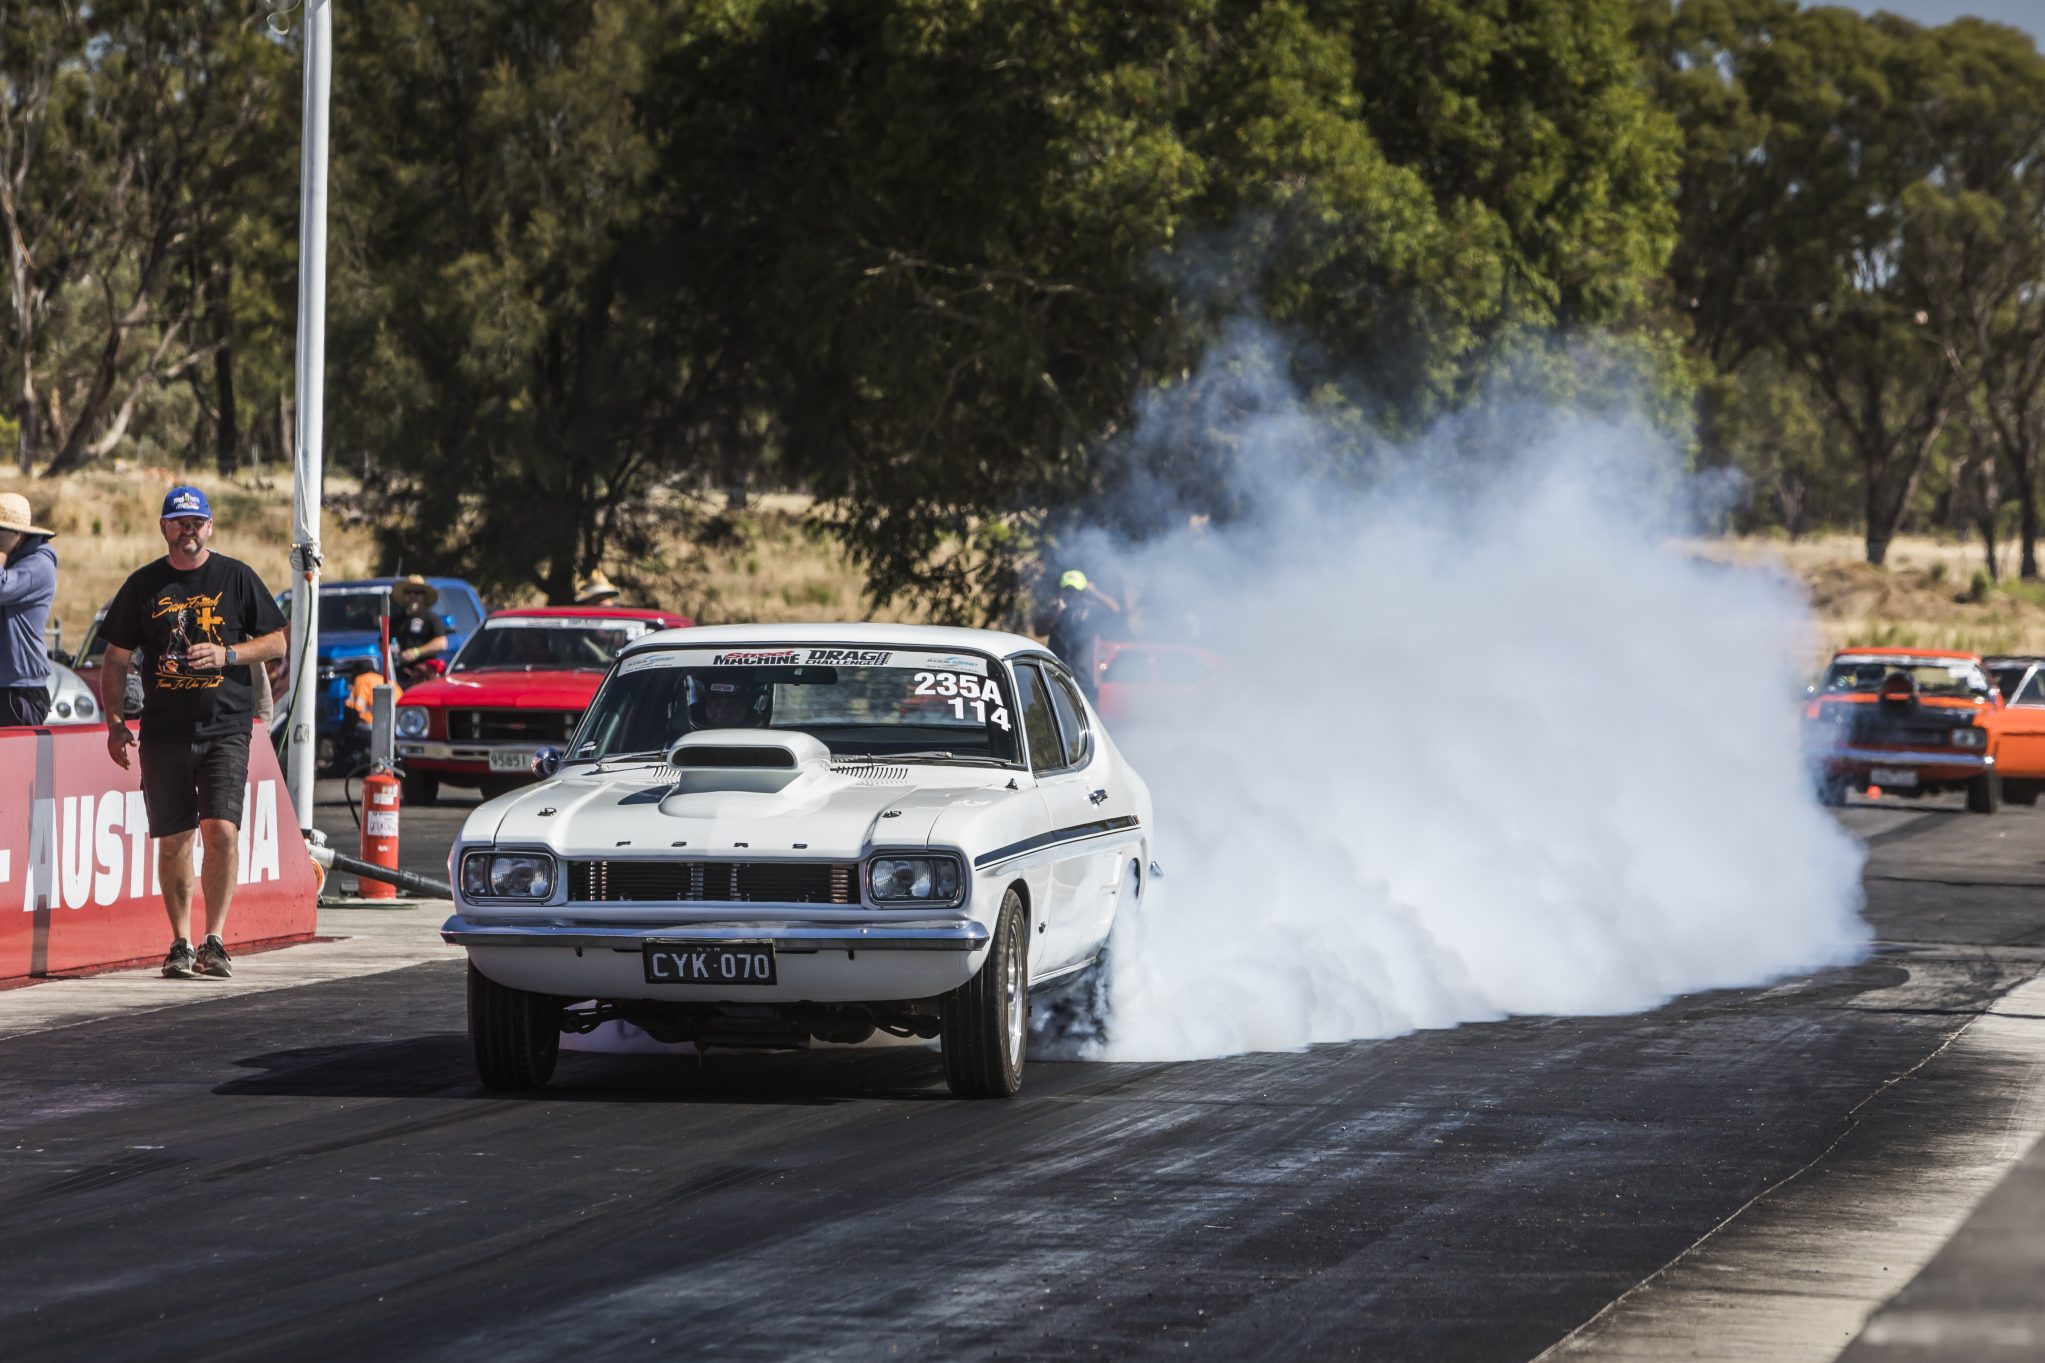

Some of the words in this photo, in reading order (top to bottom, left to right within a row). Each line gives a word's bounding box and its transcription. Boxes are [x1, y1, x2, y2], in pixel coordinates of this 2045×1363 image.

[713, 654, 800, 665] MACHINE
[807, 650, 879, 660] DRAG
[913, 672, 1004, 707] 235A
[947, 696, 1011, 732] 114
[23, 779, 280, 912] AUSTIA
[652, 953, 709, 978] CYK
[720, 953, 770, 979] 070
